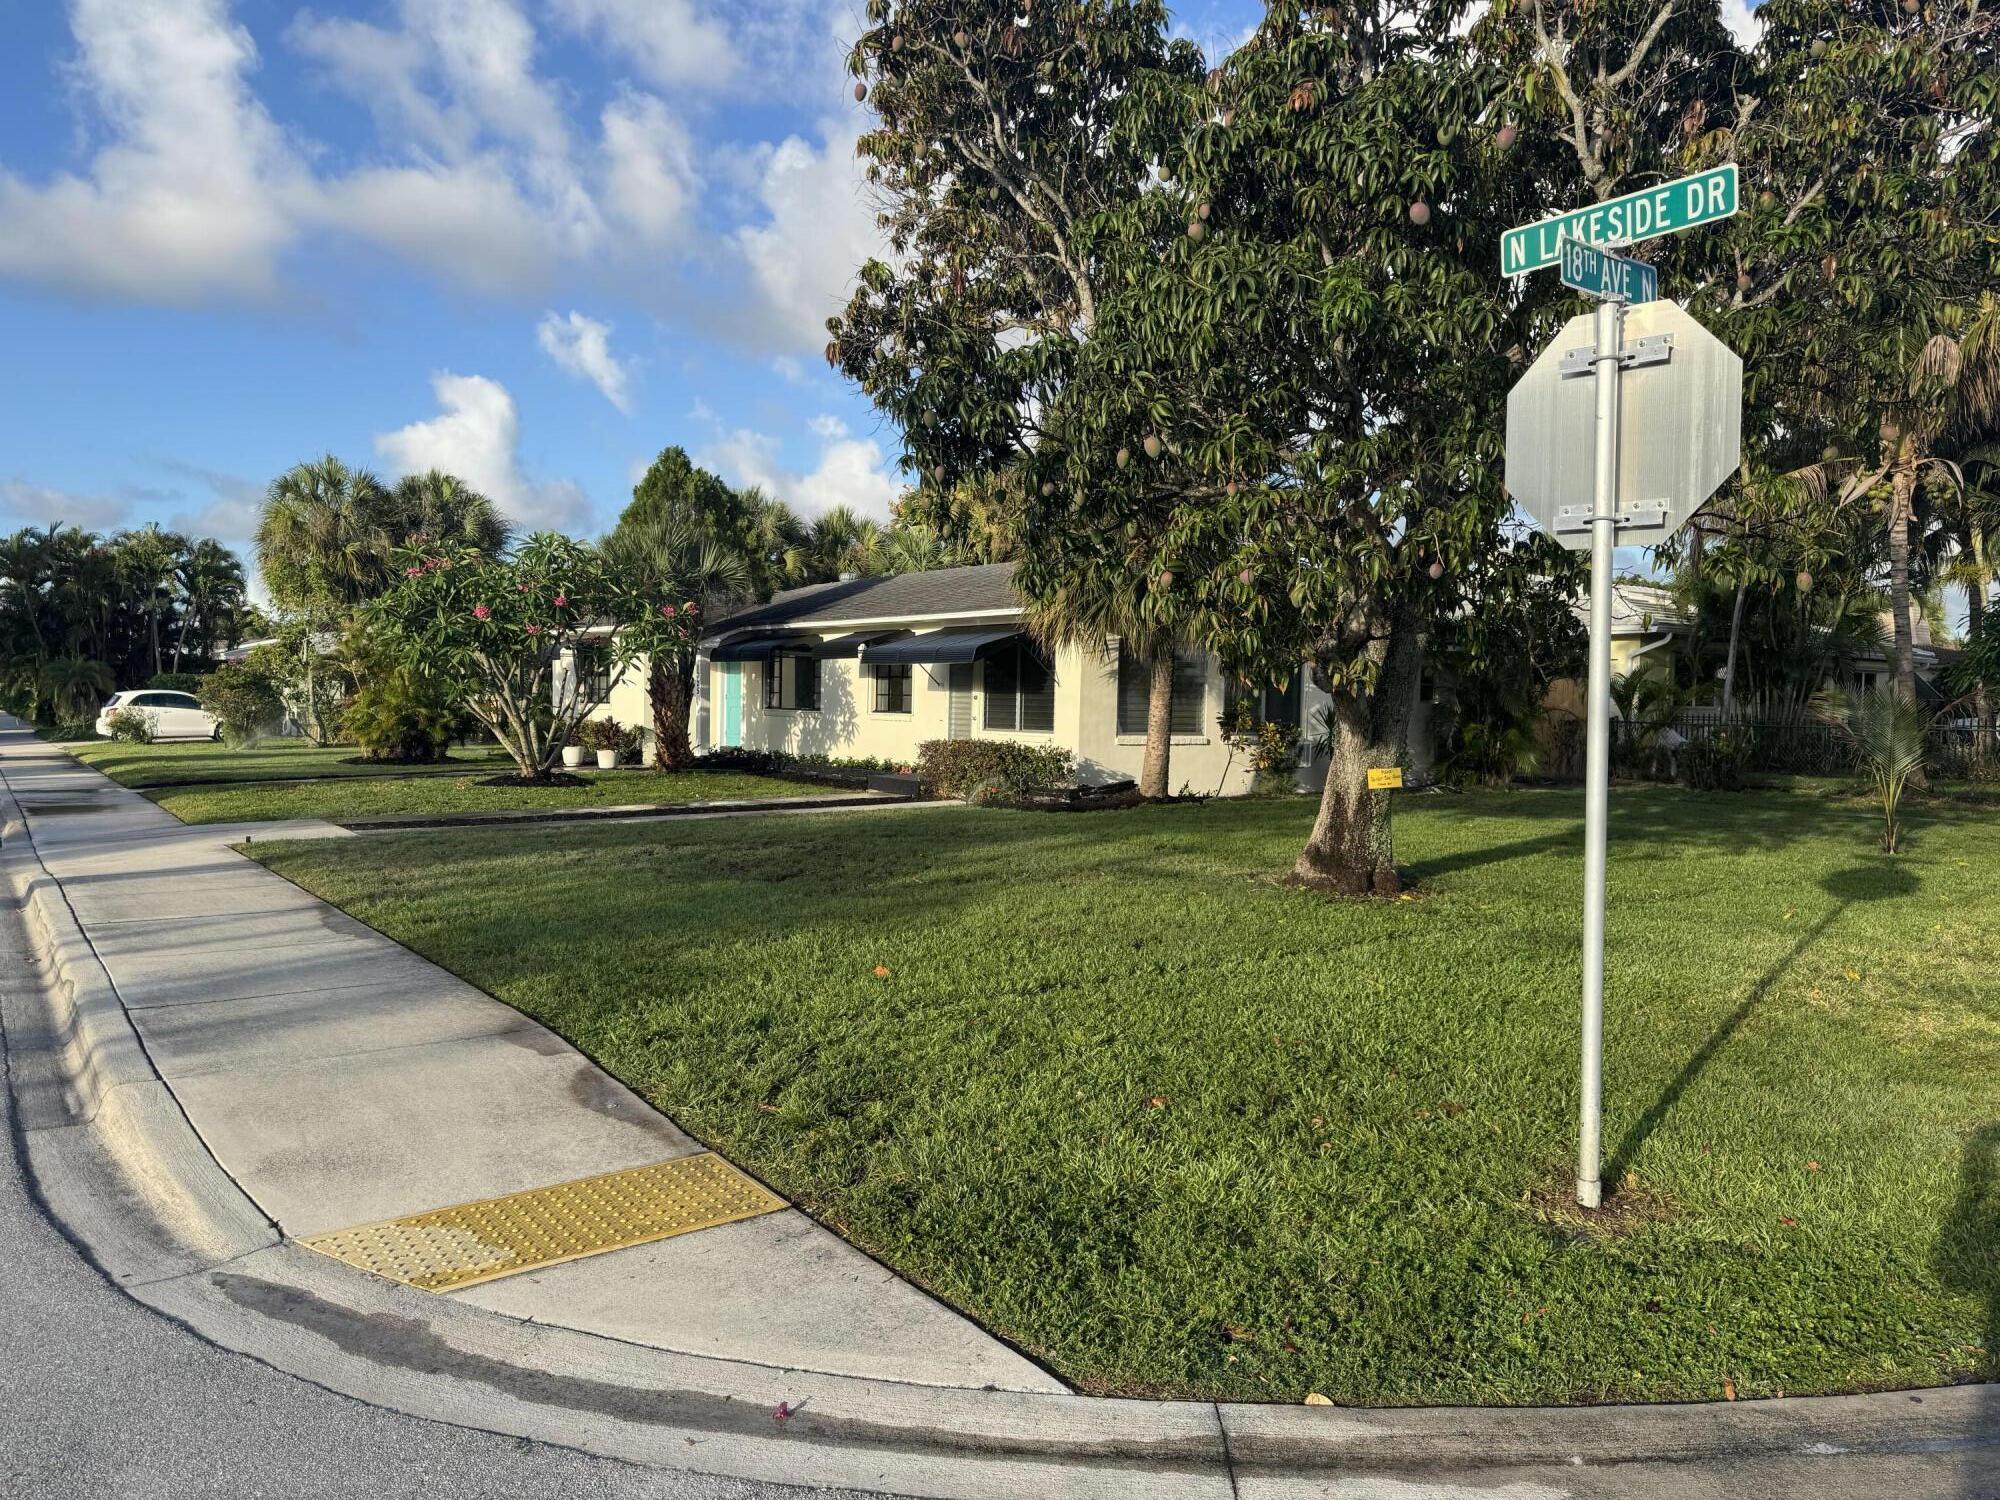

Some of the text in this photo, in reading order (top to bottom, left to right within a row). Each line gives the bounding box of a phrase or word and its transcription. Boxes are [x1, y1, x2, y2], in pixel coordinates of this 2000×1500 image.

[1510, 176, 1726, 268] N LAKESIDE DR
[1566, 243, 1653, 302] 18TH AVE N
